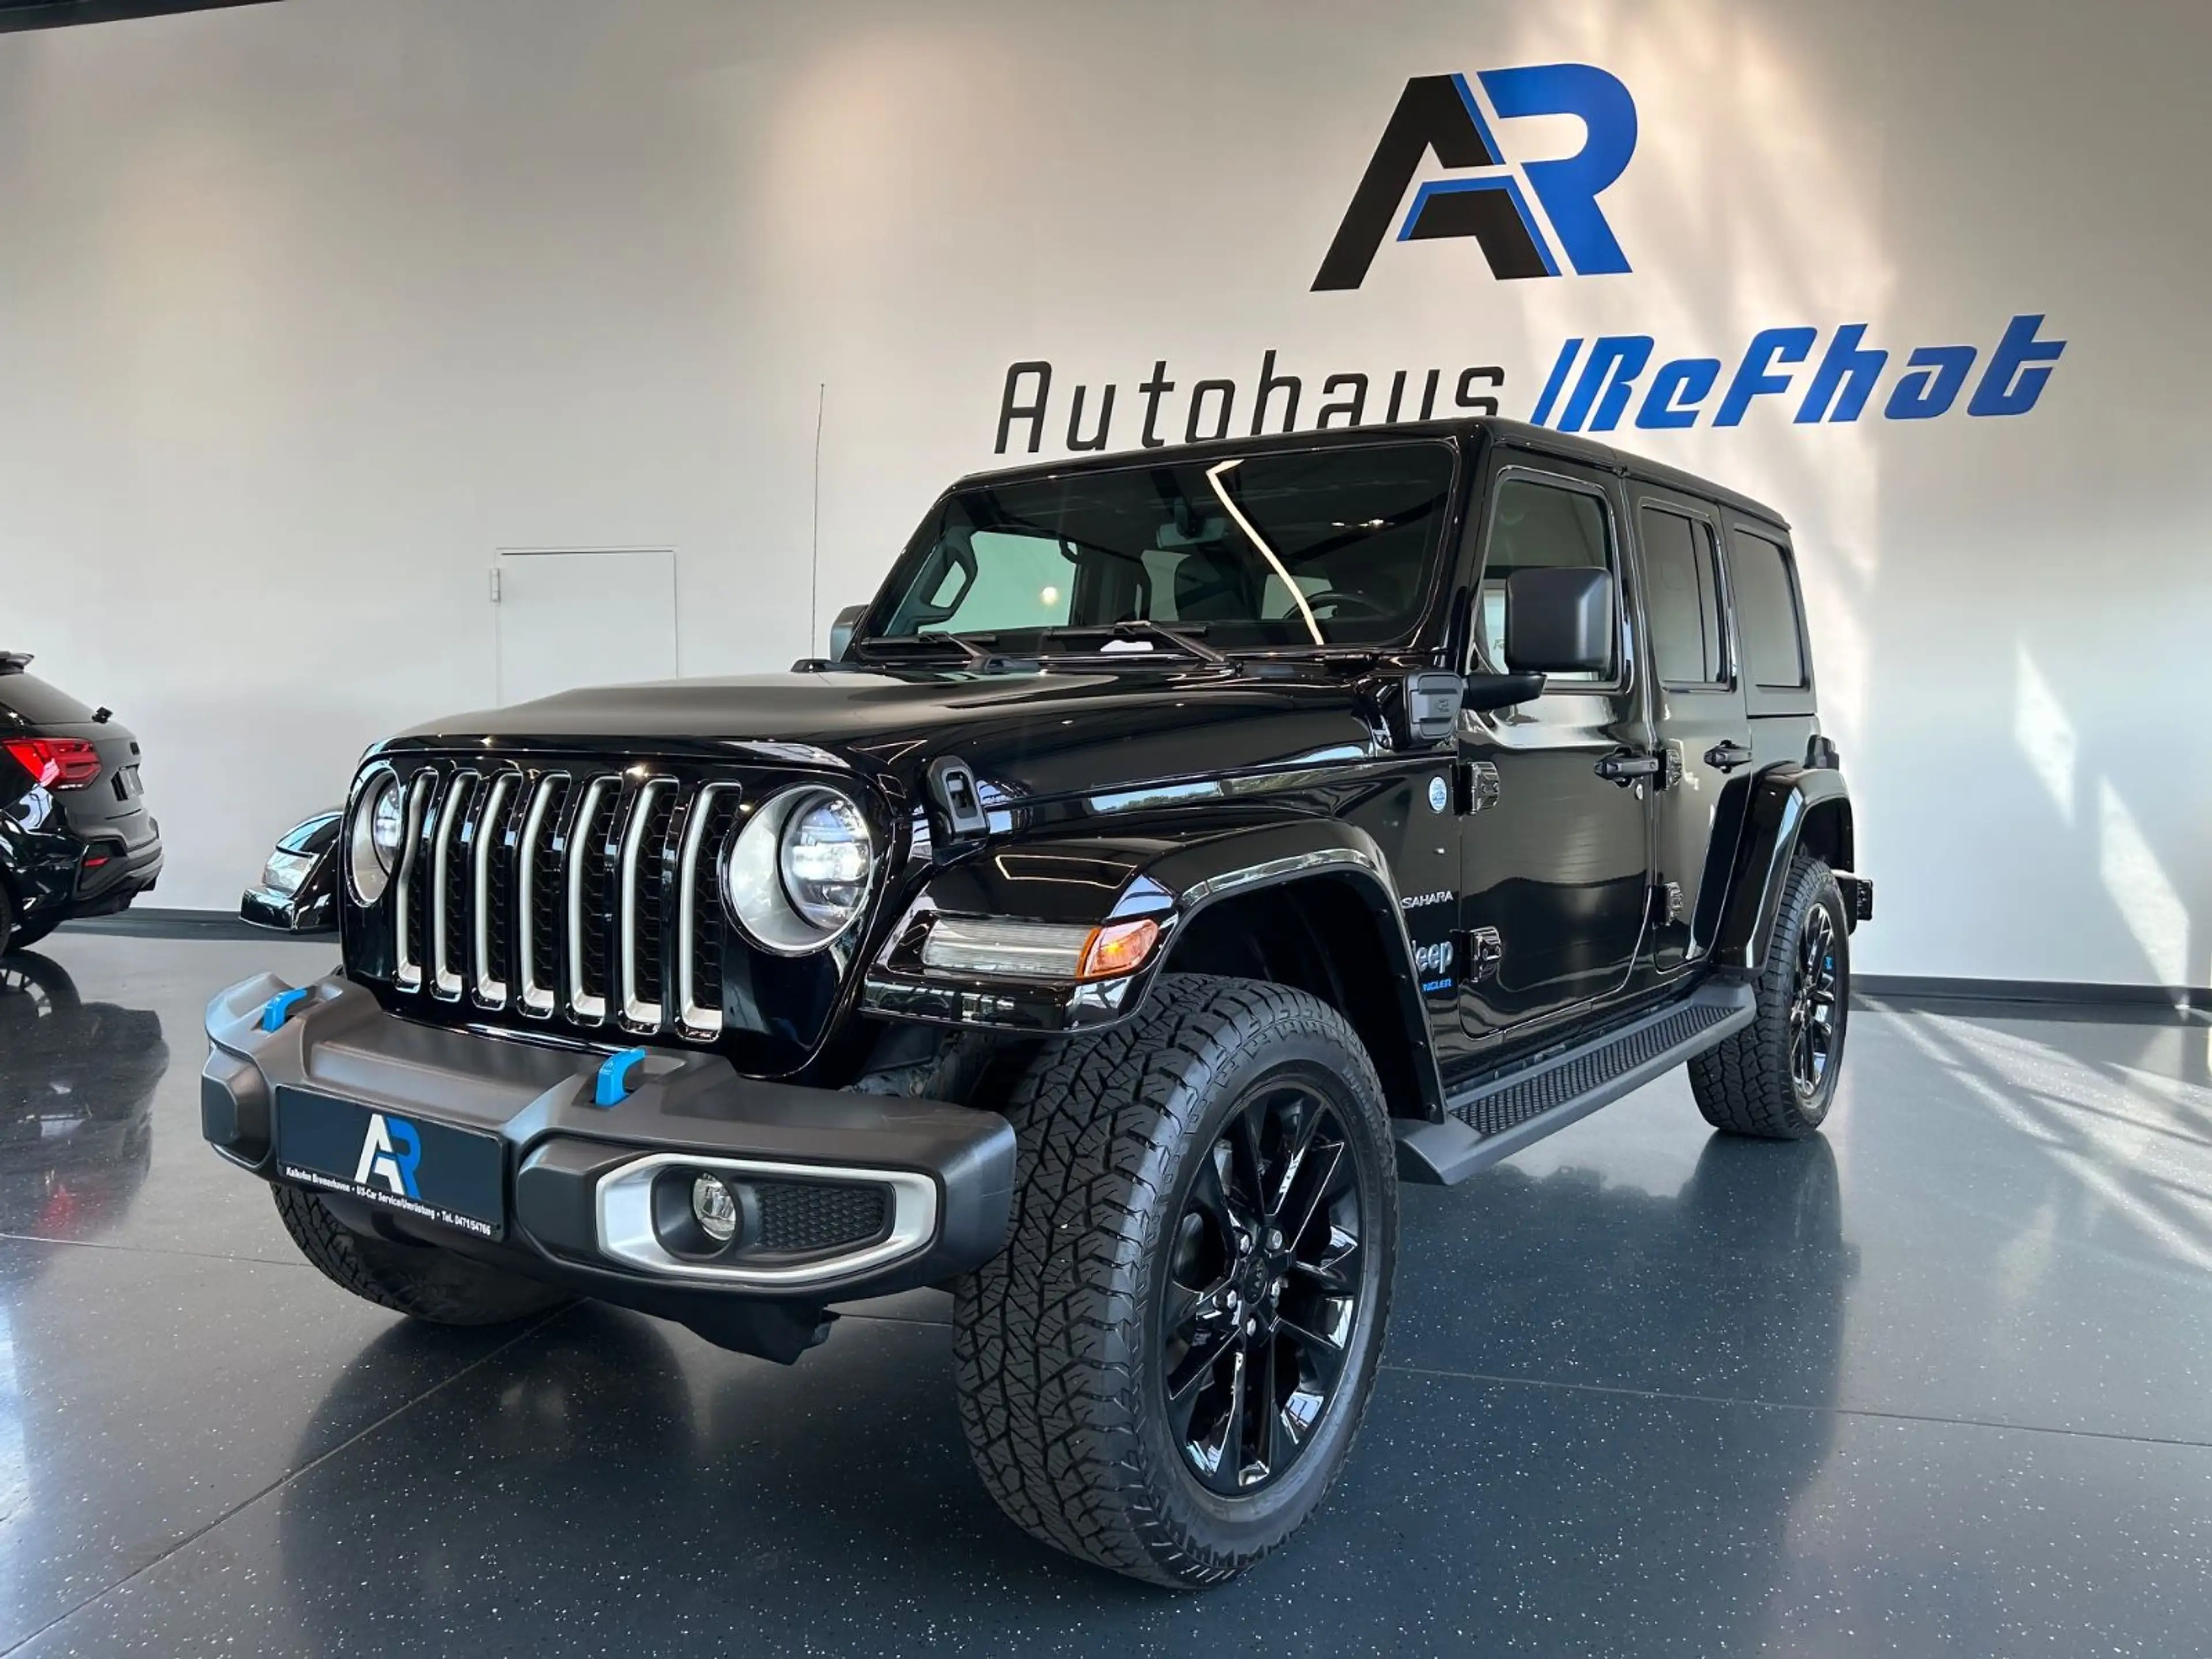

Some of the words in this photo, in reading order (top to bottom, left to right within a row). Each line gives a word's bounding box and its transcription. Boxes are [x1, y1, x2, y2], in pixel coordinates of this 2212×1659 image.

[1309, 62, 1638, 292] AR
[994, 349, 1505, 454] Autohaus
[1400, 890, 1454, 910] SAHARA
[354, 1113, 422, 1200] AR
[441, 1210, 454, 1224] Tel.
